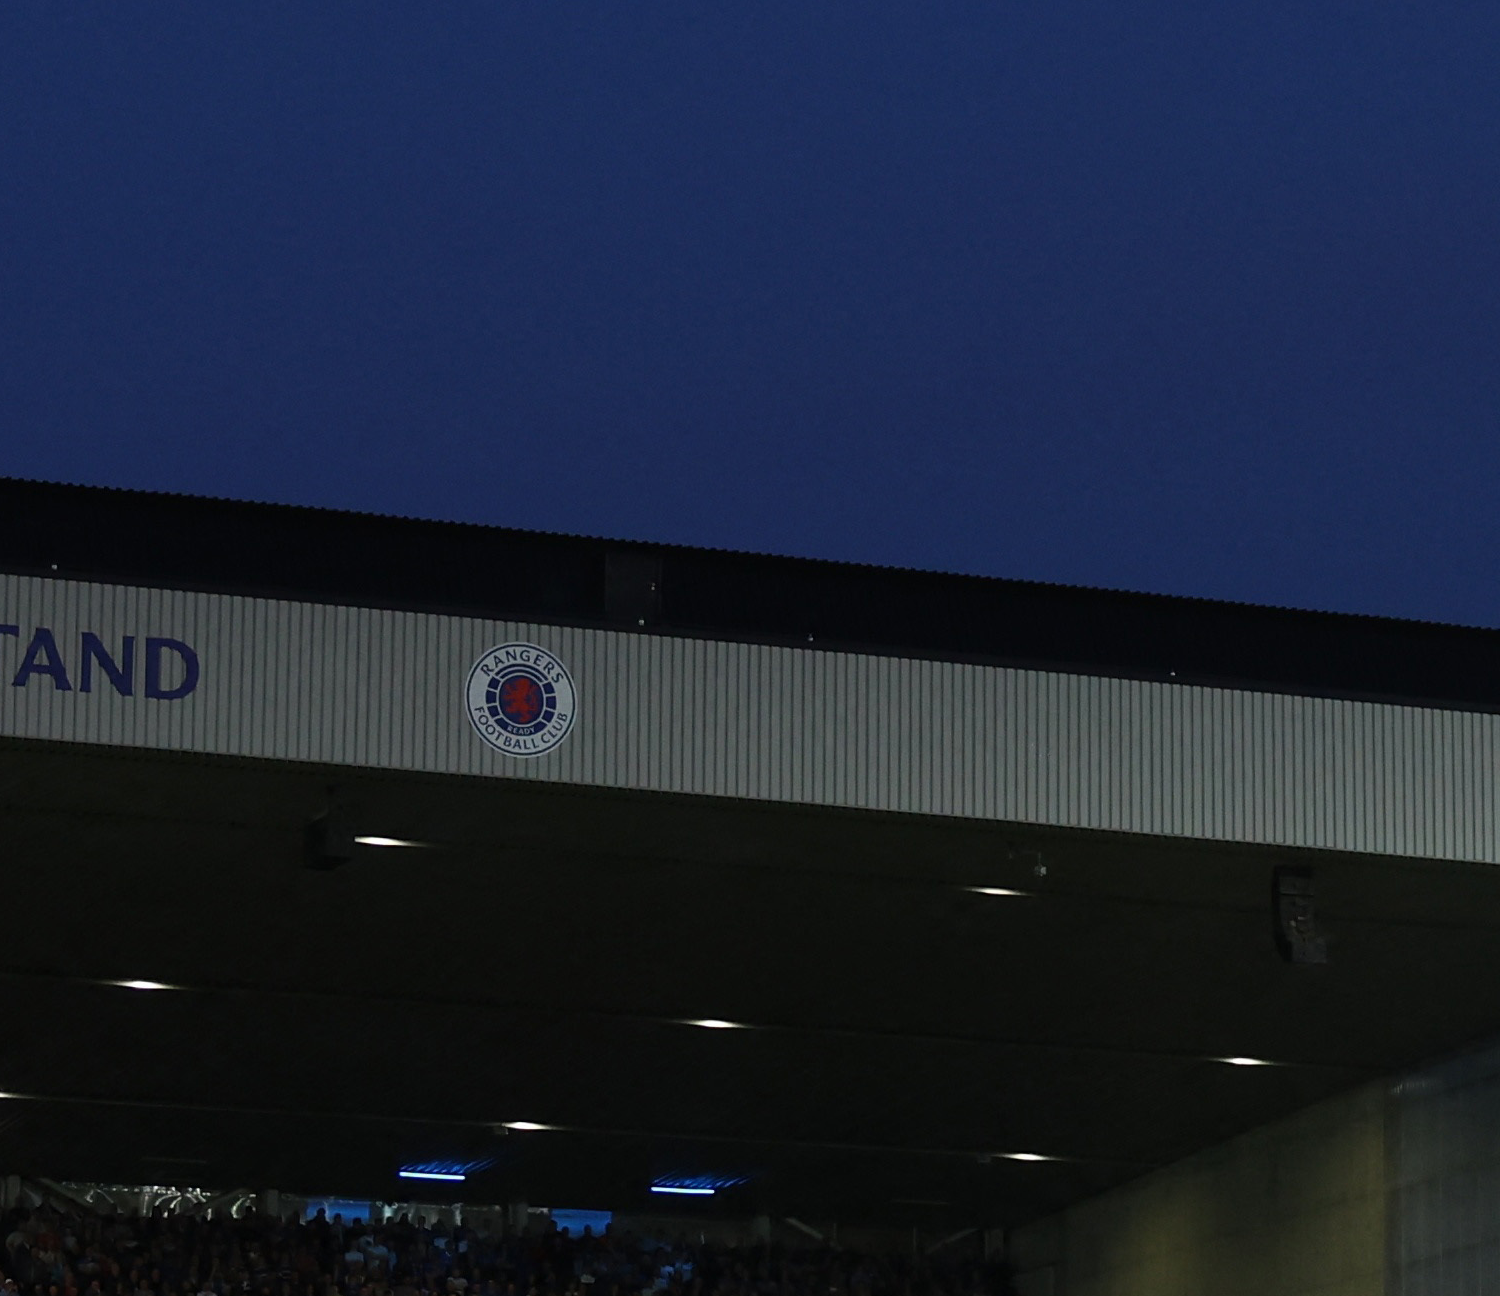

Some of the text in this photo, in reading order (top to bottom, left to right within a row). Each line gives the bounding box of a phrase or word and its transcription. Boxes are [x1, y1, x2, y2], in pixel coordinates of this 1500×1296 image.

[480, 649, 564, 684] RANGERS
[474, 706, 568, 750] FOOTBALL CLUB
[507, 725, 536, 735] READY
